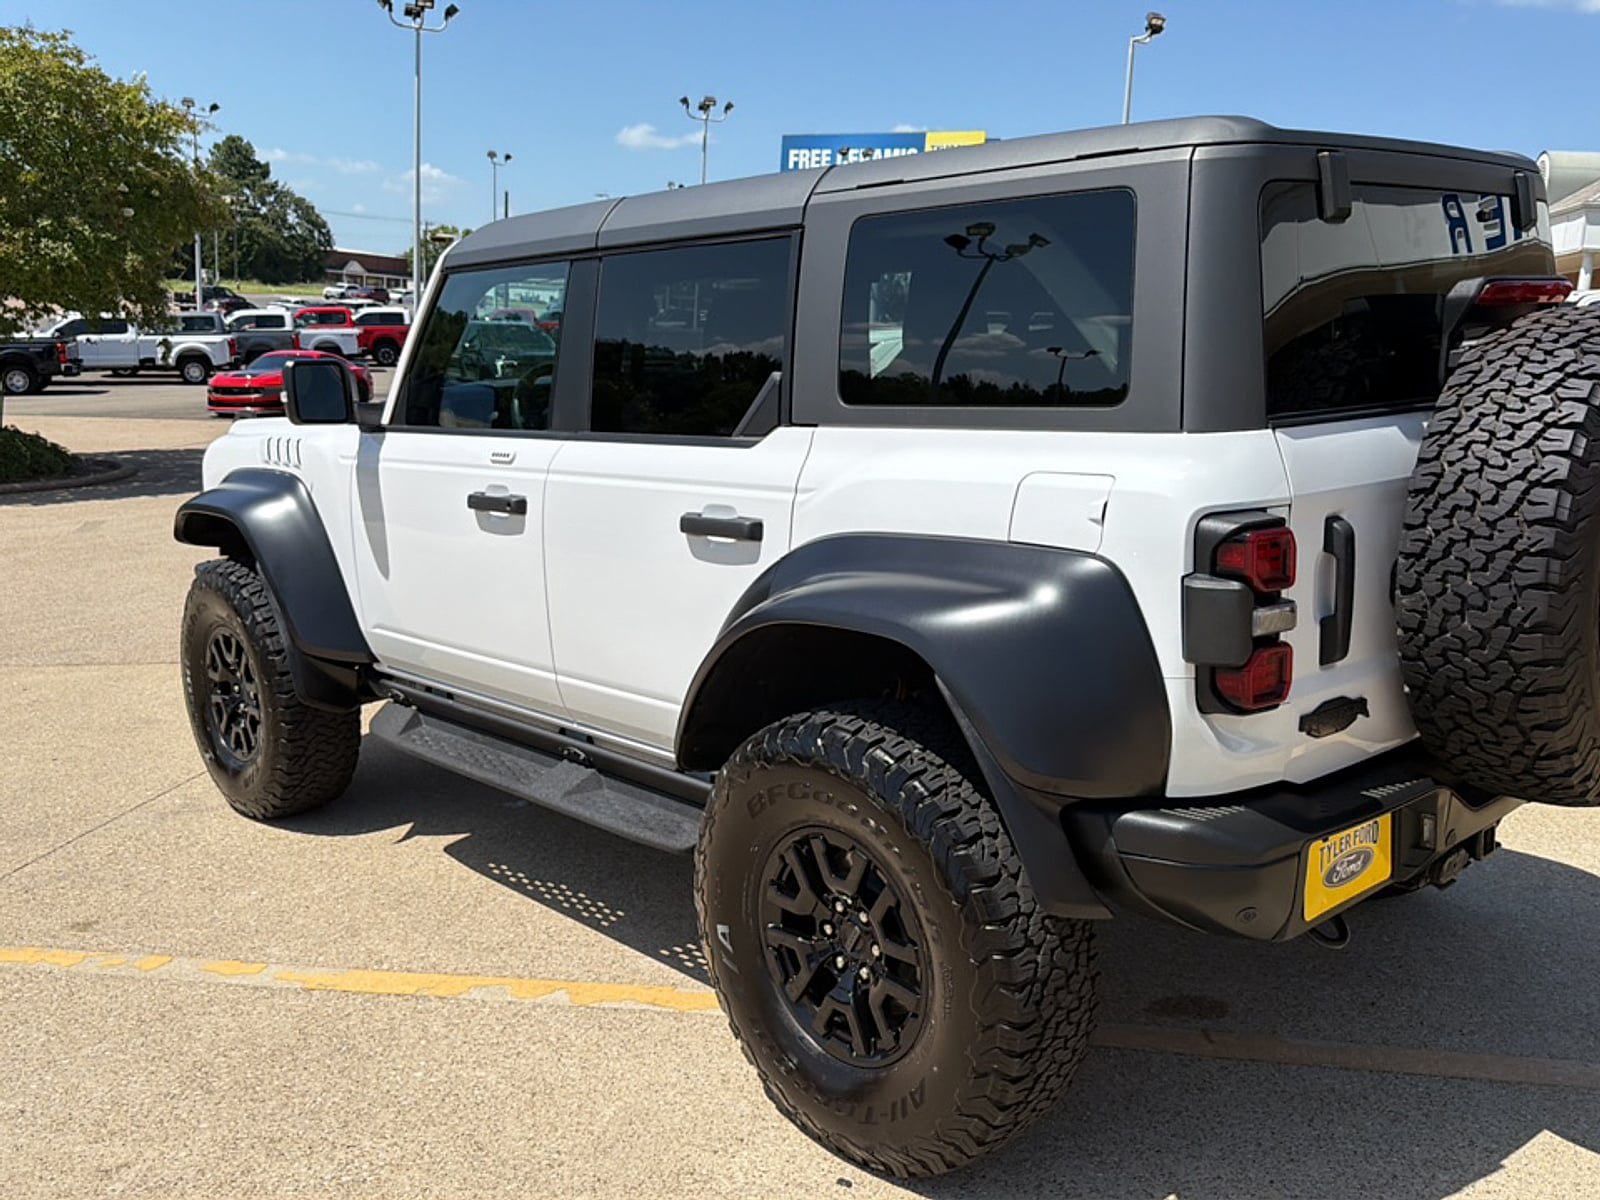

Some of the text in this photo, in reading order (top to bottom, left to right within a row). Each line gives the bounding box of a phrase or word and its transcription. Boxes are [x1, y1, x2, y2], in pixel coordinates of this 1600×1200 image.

[788, 149, 832, 169] FREE
[1319, 834, 1351, 874] TYLER
[1331, 852, 1366, 884] Ford
